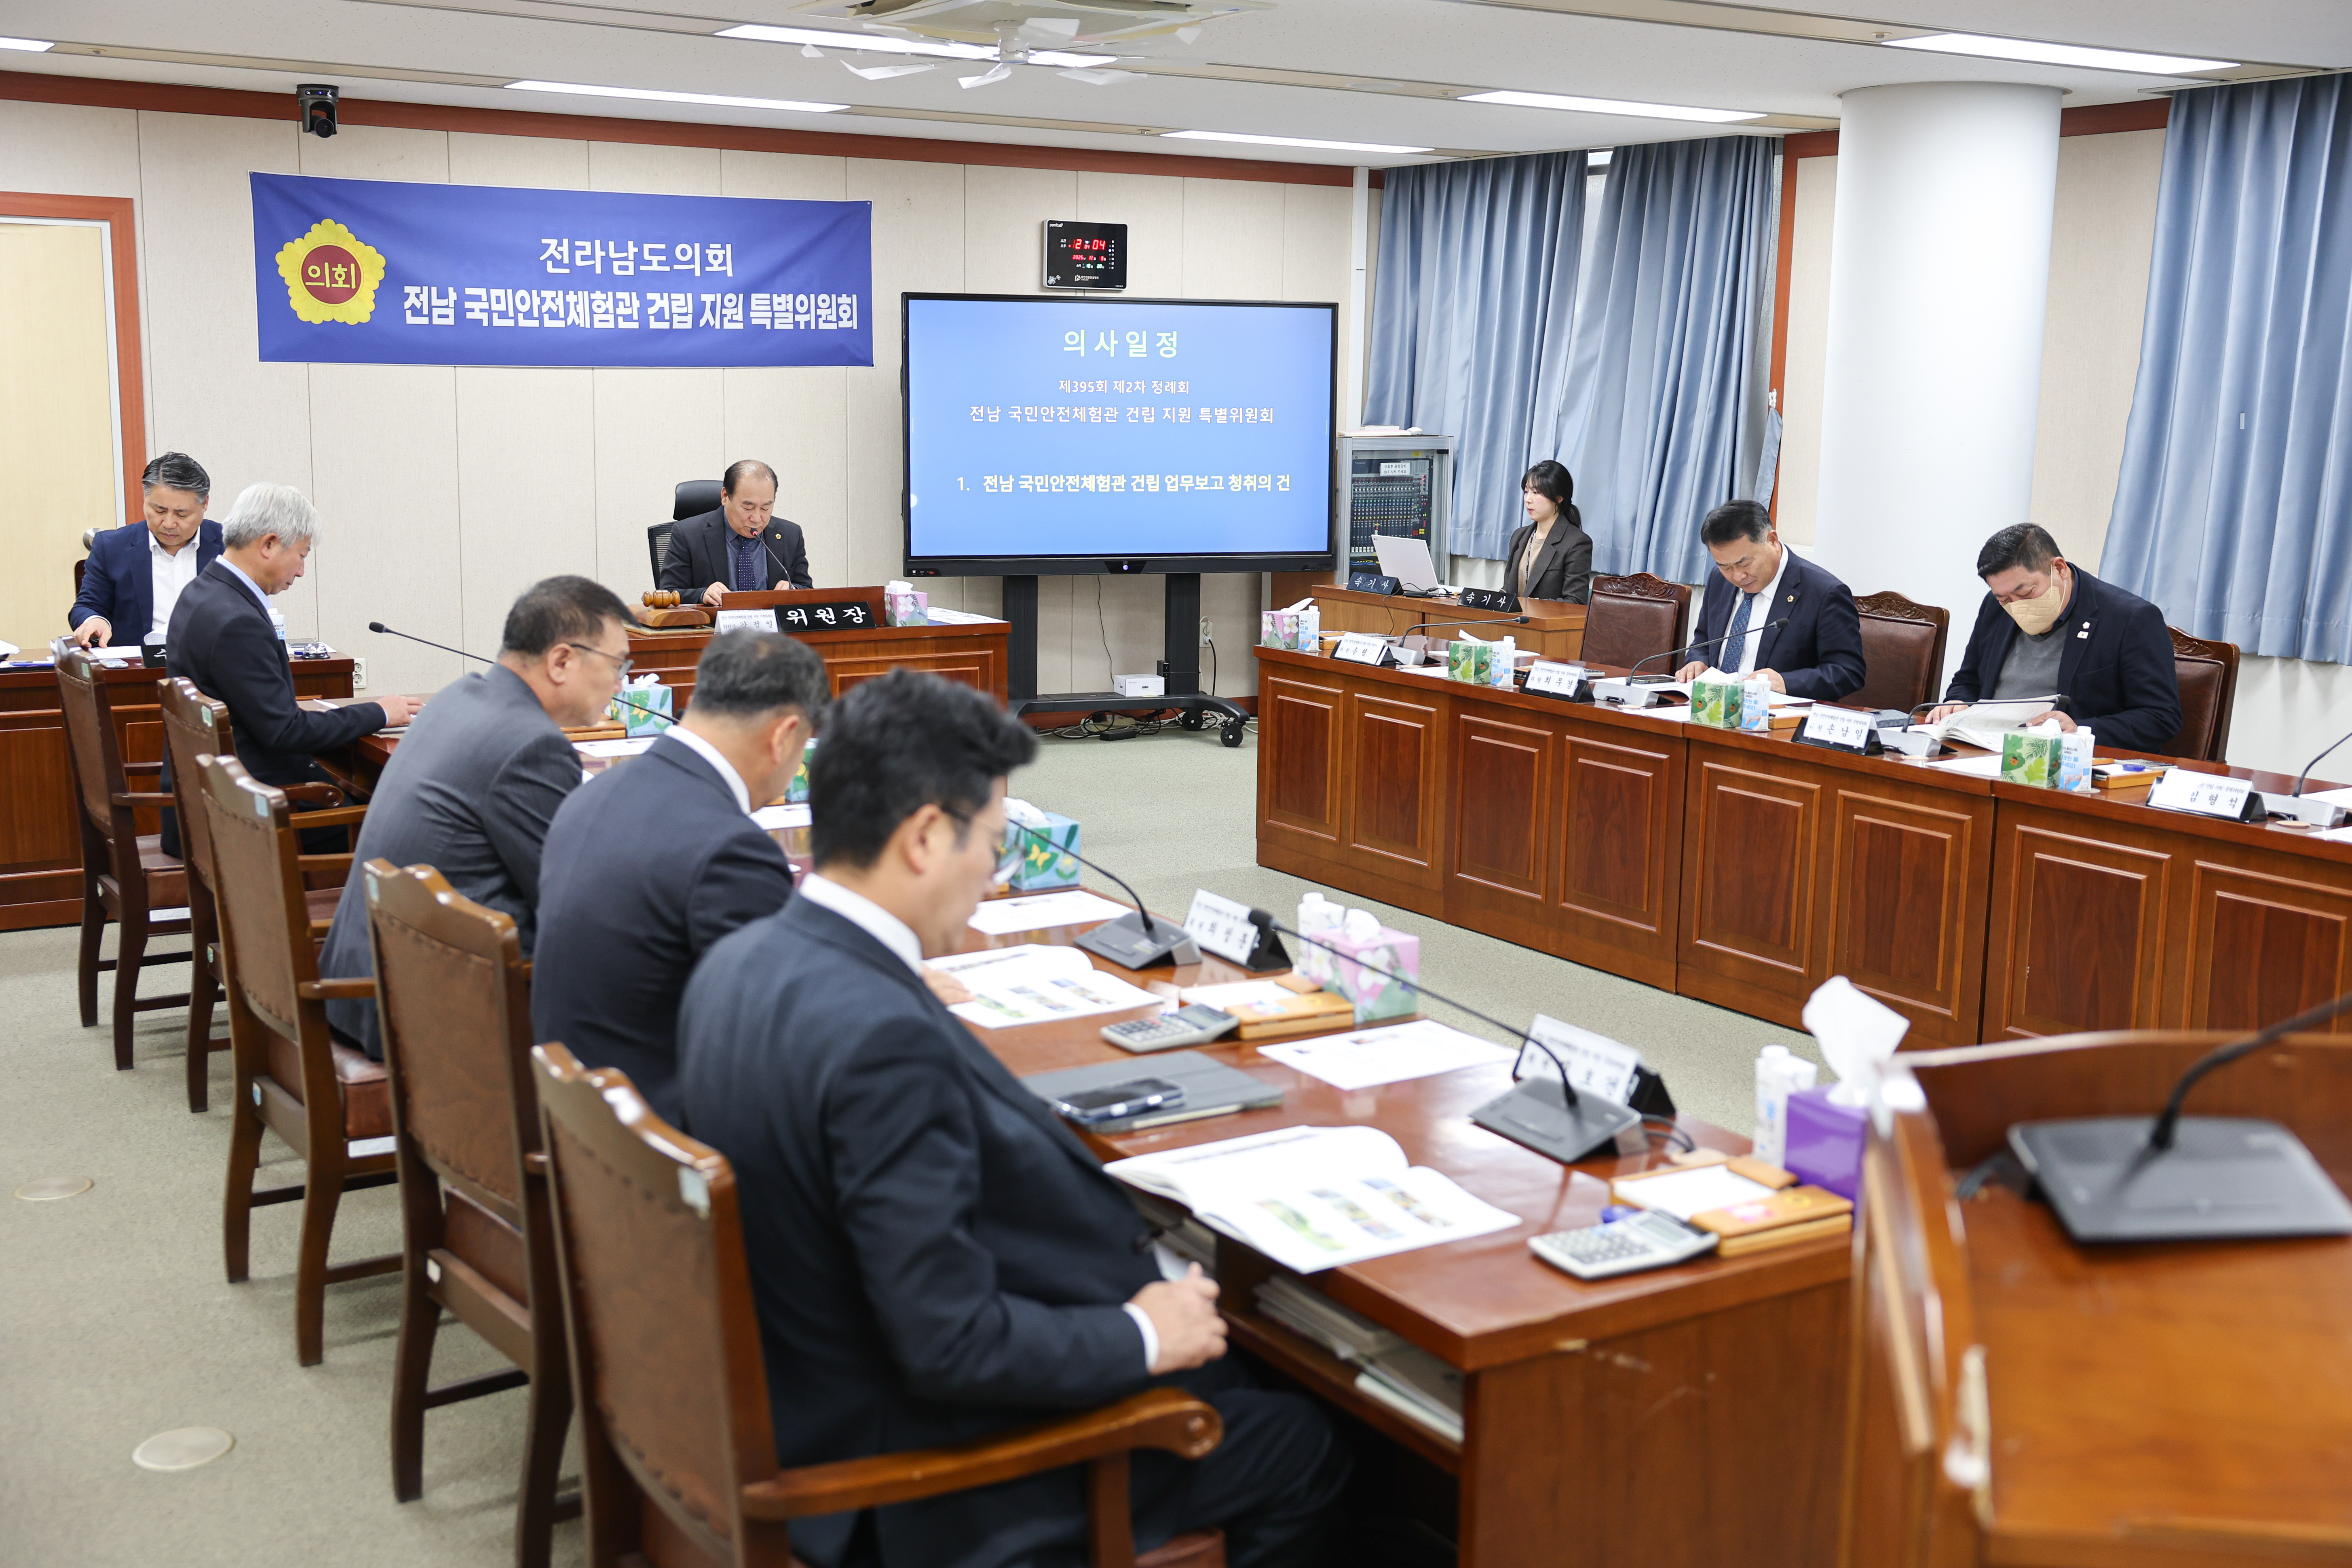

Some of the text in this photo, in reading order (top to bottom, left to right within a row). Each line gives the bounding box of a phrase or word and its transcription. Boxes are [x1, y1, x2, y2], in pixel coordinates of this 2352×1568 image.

[1092, 239, 1106, 250] 04
[540, 238, 733, 277] 전라남도의회
[305, 262, 357, 290] 의회
[404, 286, 857, 329] 전남 국민안전체험관 건립 지원 특별위원회
[1063, 329, 1177, 358] 의사일정
[1059, 379, 1189, 395] 제395회 제2차 정례회
[970, 405, 1273, 424] 전남 국민안전체험관 건립 지원 특별위원회
[957, 474, 1290, 492] 1. 전남 국민안전체험관 건립 업무보고 청취의 건
[1354, 576, 1389, 590] 속기사
[1466, 591, 1506, 608] 속기사
[786, 606, 866, 626] 위원장
[1827, 723, 1863, 740] 손남일
[2190, 791, 2238, 808] 김형석
